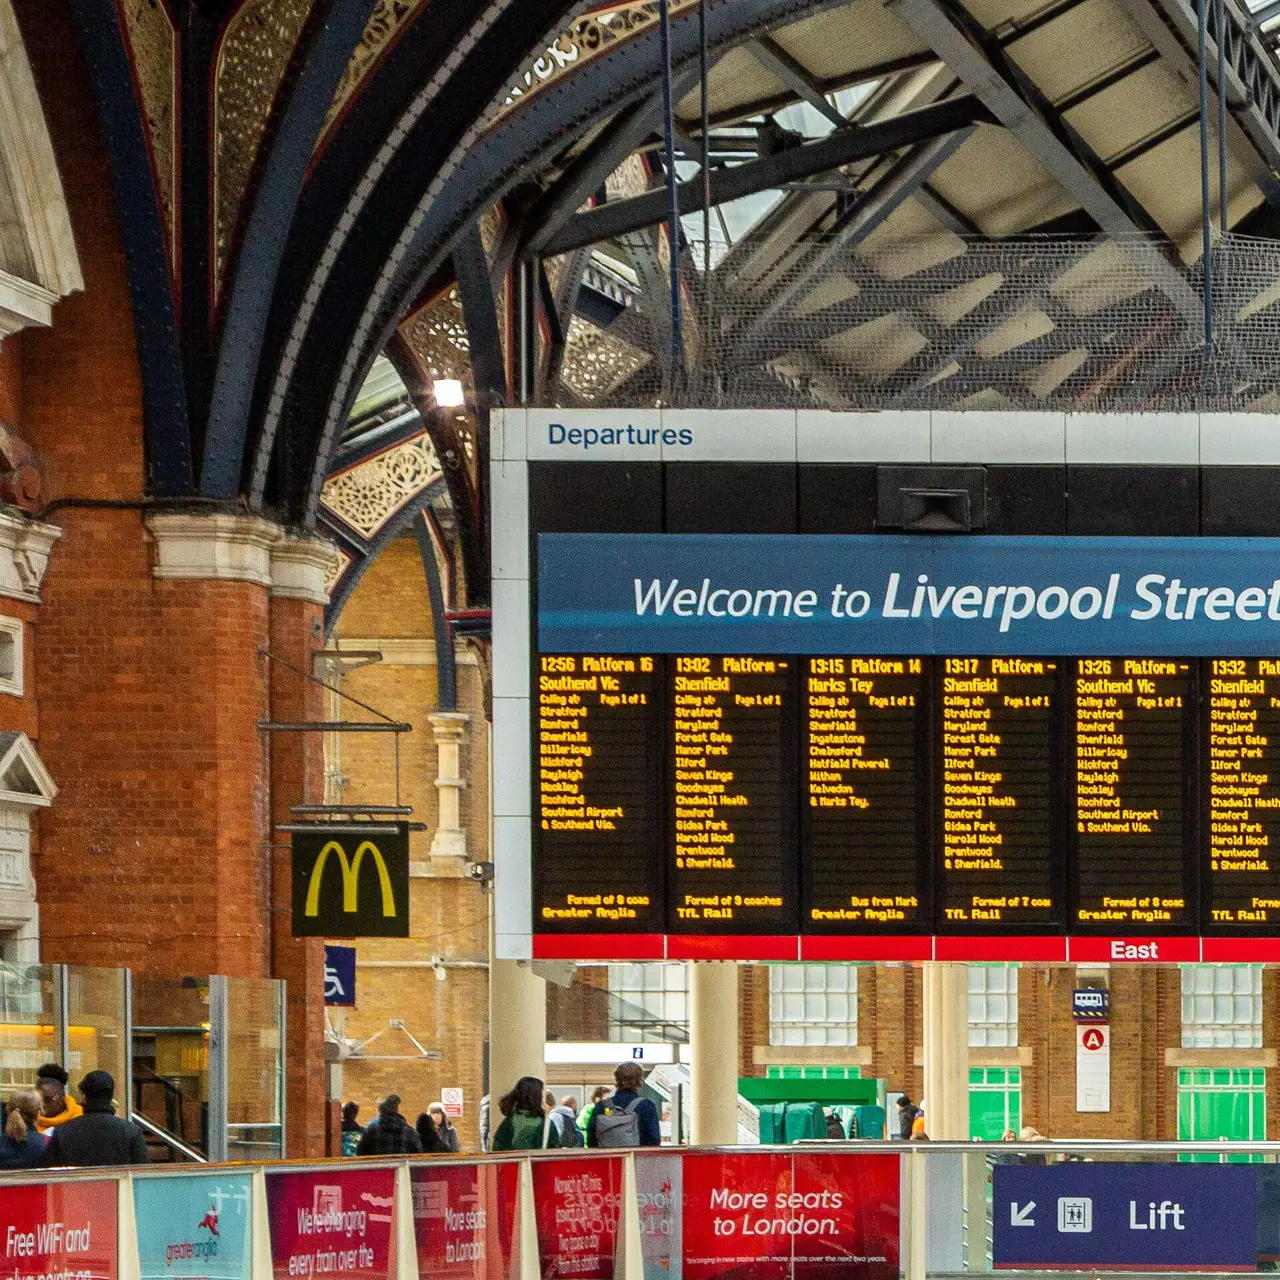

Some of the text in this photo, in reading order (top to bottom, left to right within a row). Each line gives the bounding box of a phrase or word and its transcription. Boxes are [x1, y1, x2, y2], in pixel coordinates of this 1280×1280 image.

[549, 424, 692, 449] Departures
[635, 579, 816, 616] Welcome
[832, 585, 869, 616] to
[883, 574, 1119, 632] Liverpool
[542, 657, 652, 672] 12:56 Platform 16
[540, 676, 619, 690] Southend Vic
[540, 707, 587, 716] Stratford
[1112, 941, 1158, 958] East
[710, 1188, 843, 1209] More seats
[1130, 1201, 1184, 1230] Lift
[713, 1217, 736, 1236] to
[6, 1221, 91, 1257] Free WiFi and
